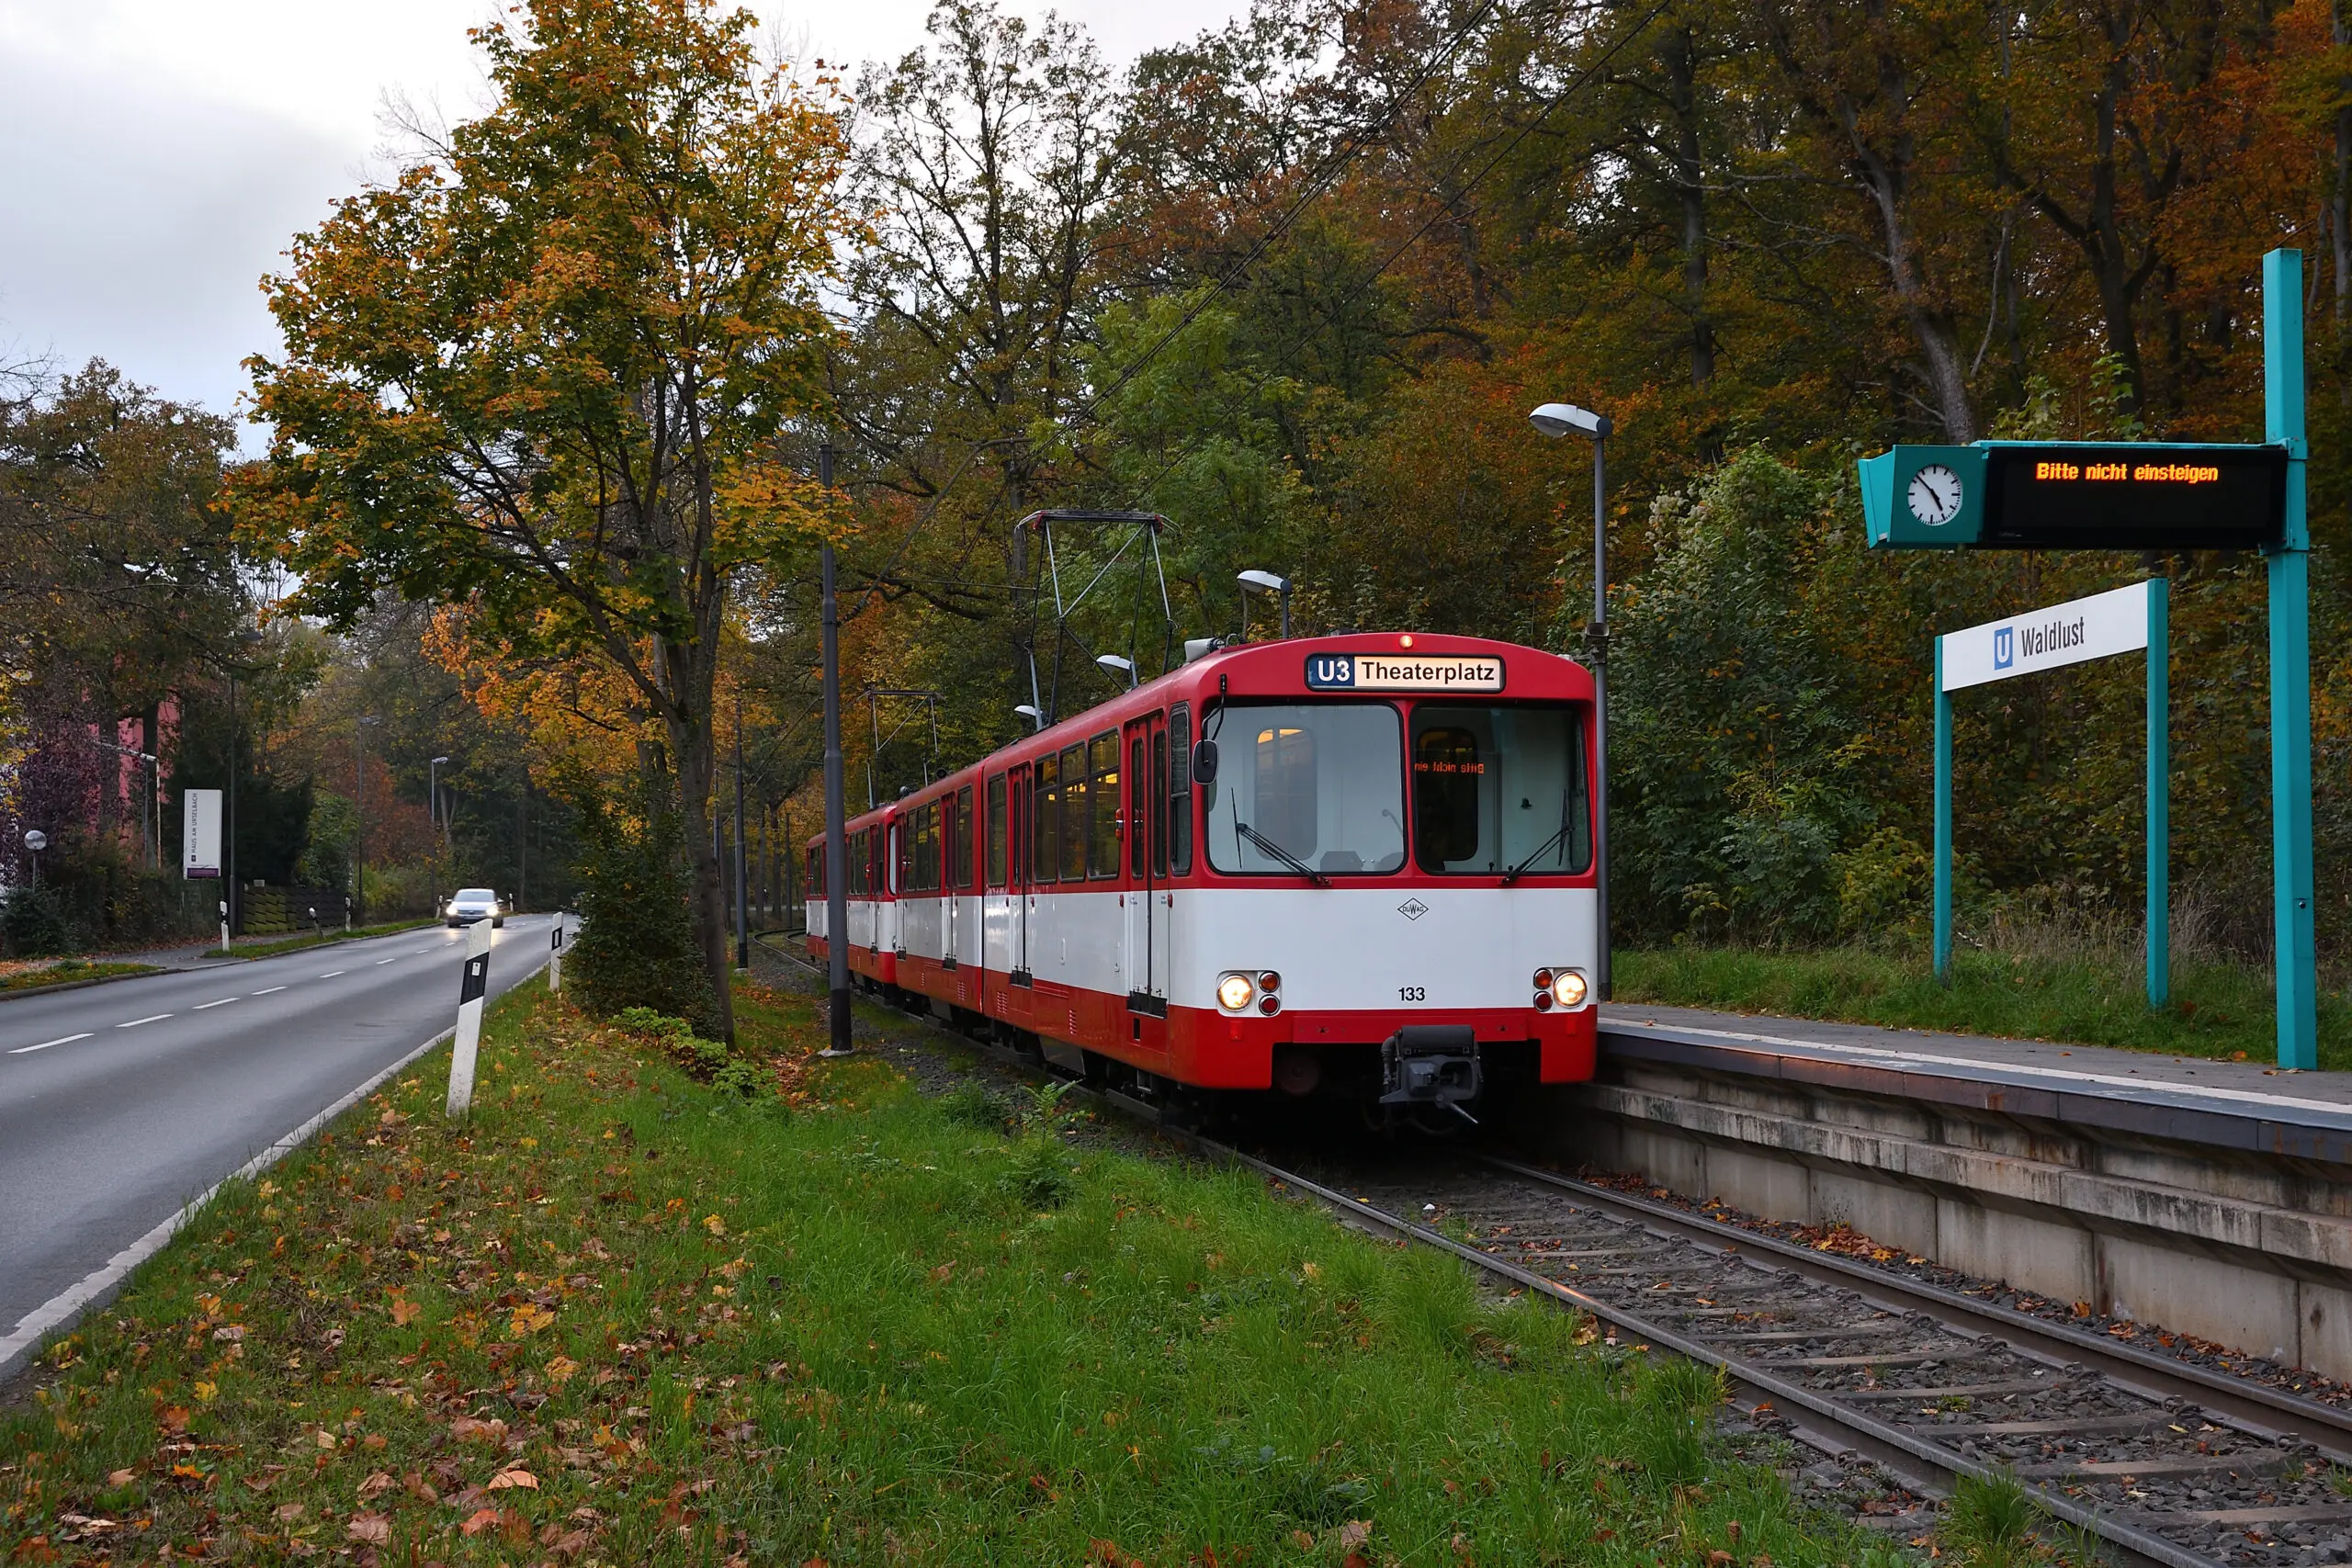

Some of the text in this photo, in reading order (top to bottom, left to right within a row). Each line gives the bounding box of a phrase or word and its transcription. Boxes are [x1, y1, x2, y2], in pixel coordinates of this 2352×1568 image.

[2036, 462, 2219, 484] Bitte nicht einsteigen
[1996, 615, 2085, 663] U Waldlust
[1317, 660, 1495, 685] U3 Theaterplatz
[191, 828, 198, 837] AM
[1402, 903, 1424, 915] DUWAG
[1397, 987, 1426, 1002] 133
